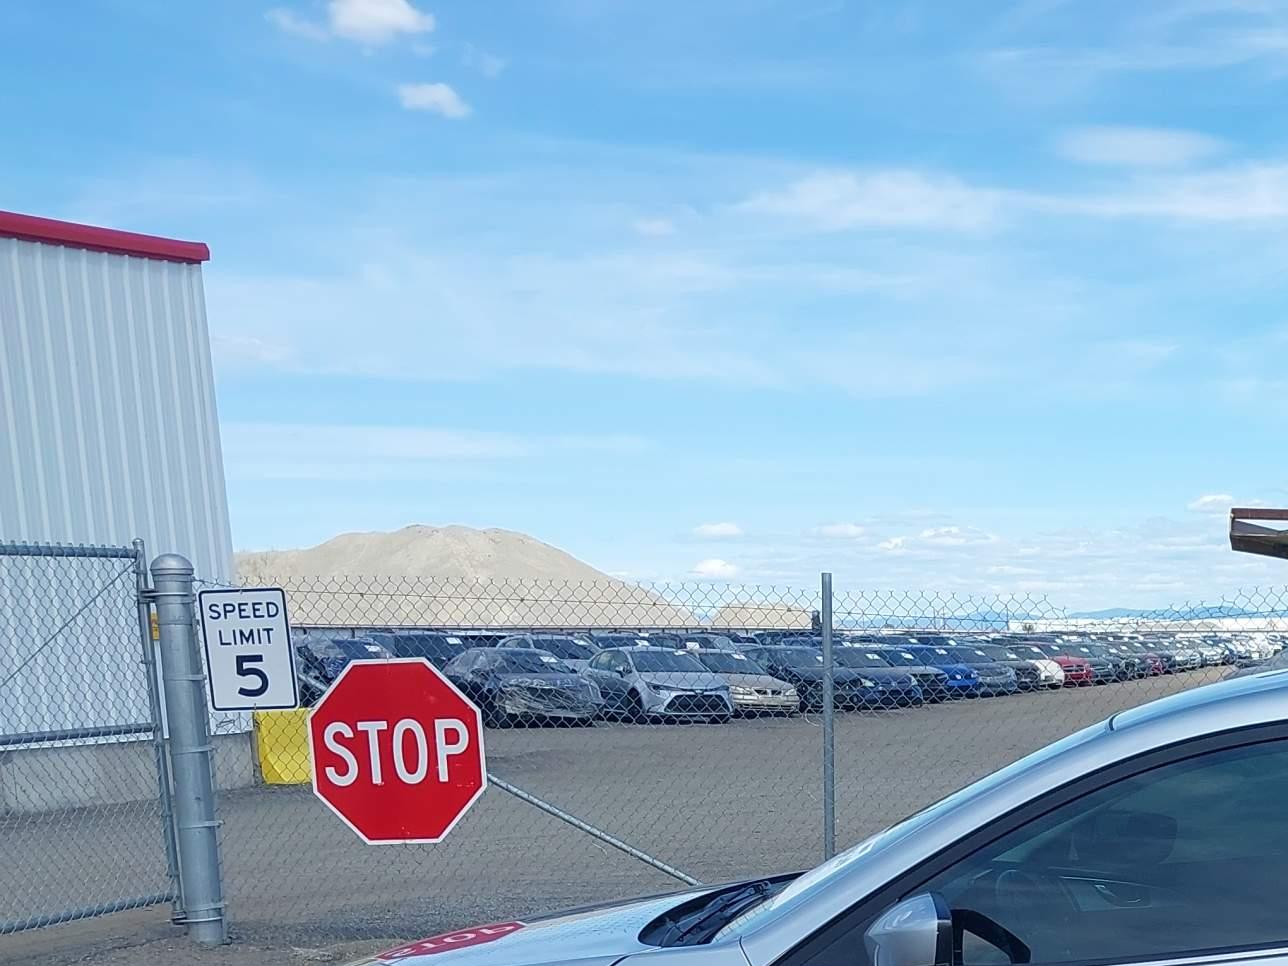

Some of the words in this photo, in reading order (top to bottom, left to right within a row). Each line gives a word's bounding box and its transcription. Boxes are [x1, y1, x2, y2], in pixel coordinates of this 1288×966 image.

[208, 601, 280, 620] SPEED
[218, 627, 274, 646] LIMIT
[235, 654, 269, 698] 5
[323, 718, 470, 787] STOP
